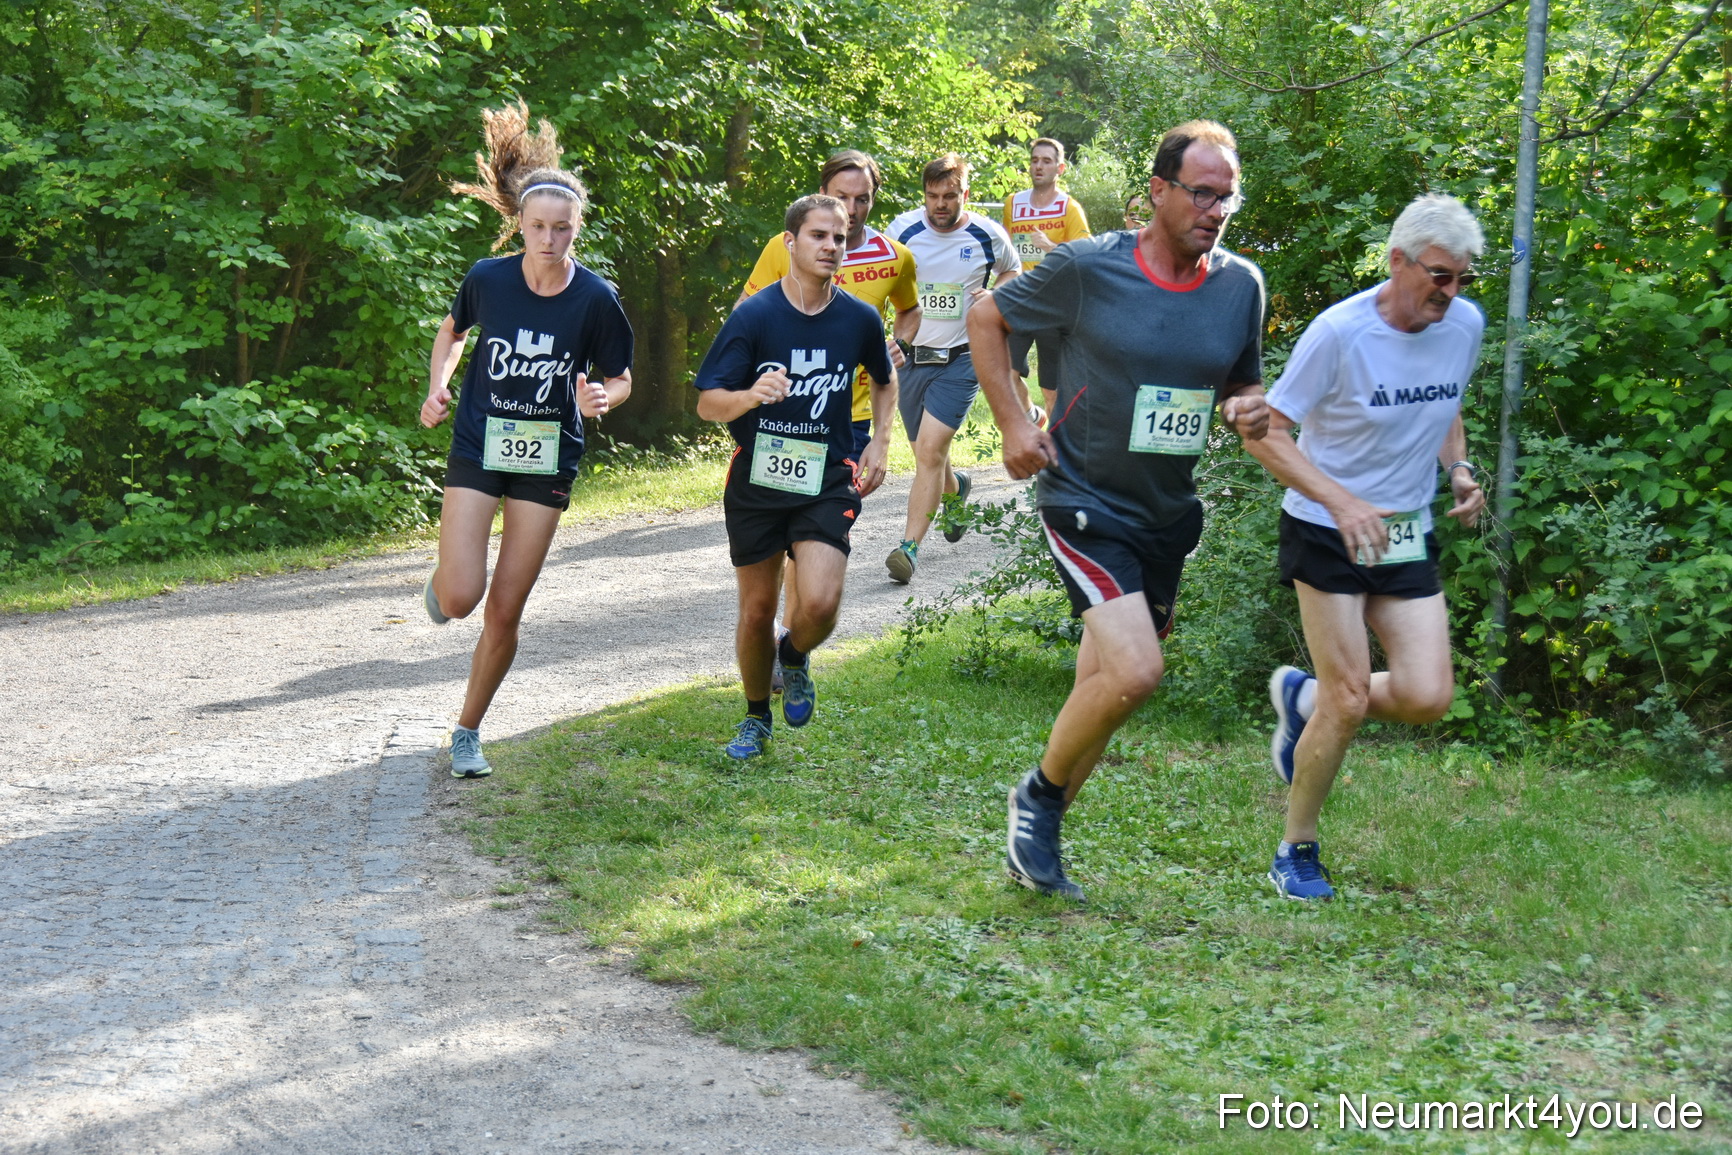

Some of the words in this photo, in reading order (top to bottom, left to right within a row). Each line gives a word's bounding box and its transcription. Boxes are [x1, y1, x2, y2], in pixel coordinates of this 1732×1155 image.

[1016, 243, 1042, 254] 1636
[853, 266, 899, 284] BÖGL
[921, 295, 956, 309] 1883
[1394, 382, 1459, 406] MAGNA
[1145, 411, 1202, 437] 1489
[500, 438, 542, 459] 392
[767, 455, 807, 479] 396
[786, 476, 808, 486] Thomas
